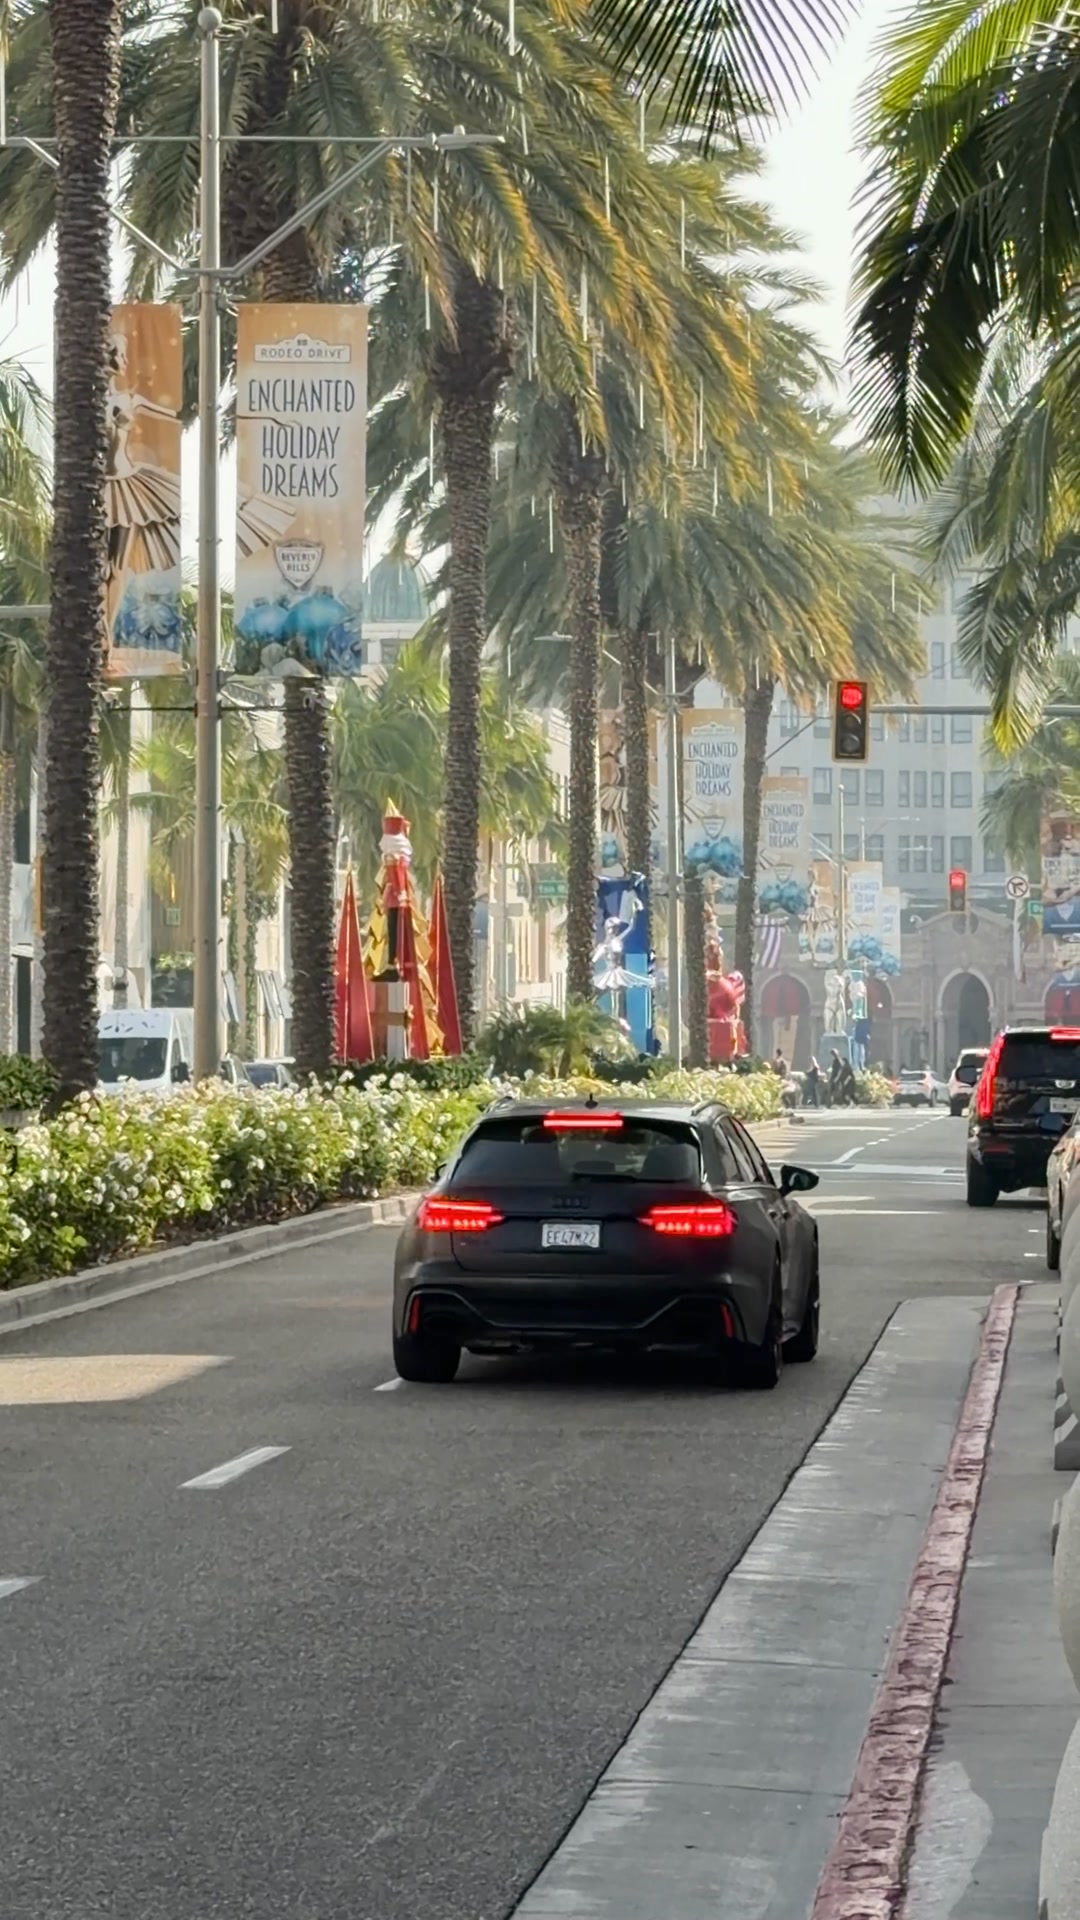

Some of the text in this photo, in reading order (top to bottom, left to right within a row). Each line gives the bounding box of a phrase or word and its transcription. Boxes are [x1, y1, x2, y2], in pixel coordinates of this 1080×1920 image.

[260, 348, 303, 359] RODEO
[248, 378, 355, 413] ENCHANTED
[262, 425, 341, 460] HOLIDAY
[262, 463, 339, 498] DREAMS
[281, 552, 316, 562] BEVERLY
[688, 742, 738, 758] ENCHANTED
[695, 763, 731, 779] HOLIDAY
[695, 781, 731, 796] DREAMS
